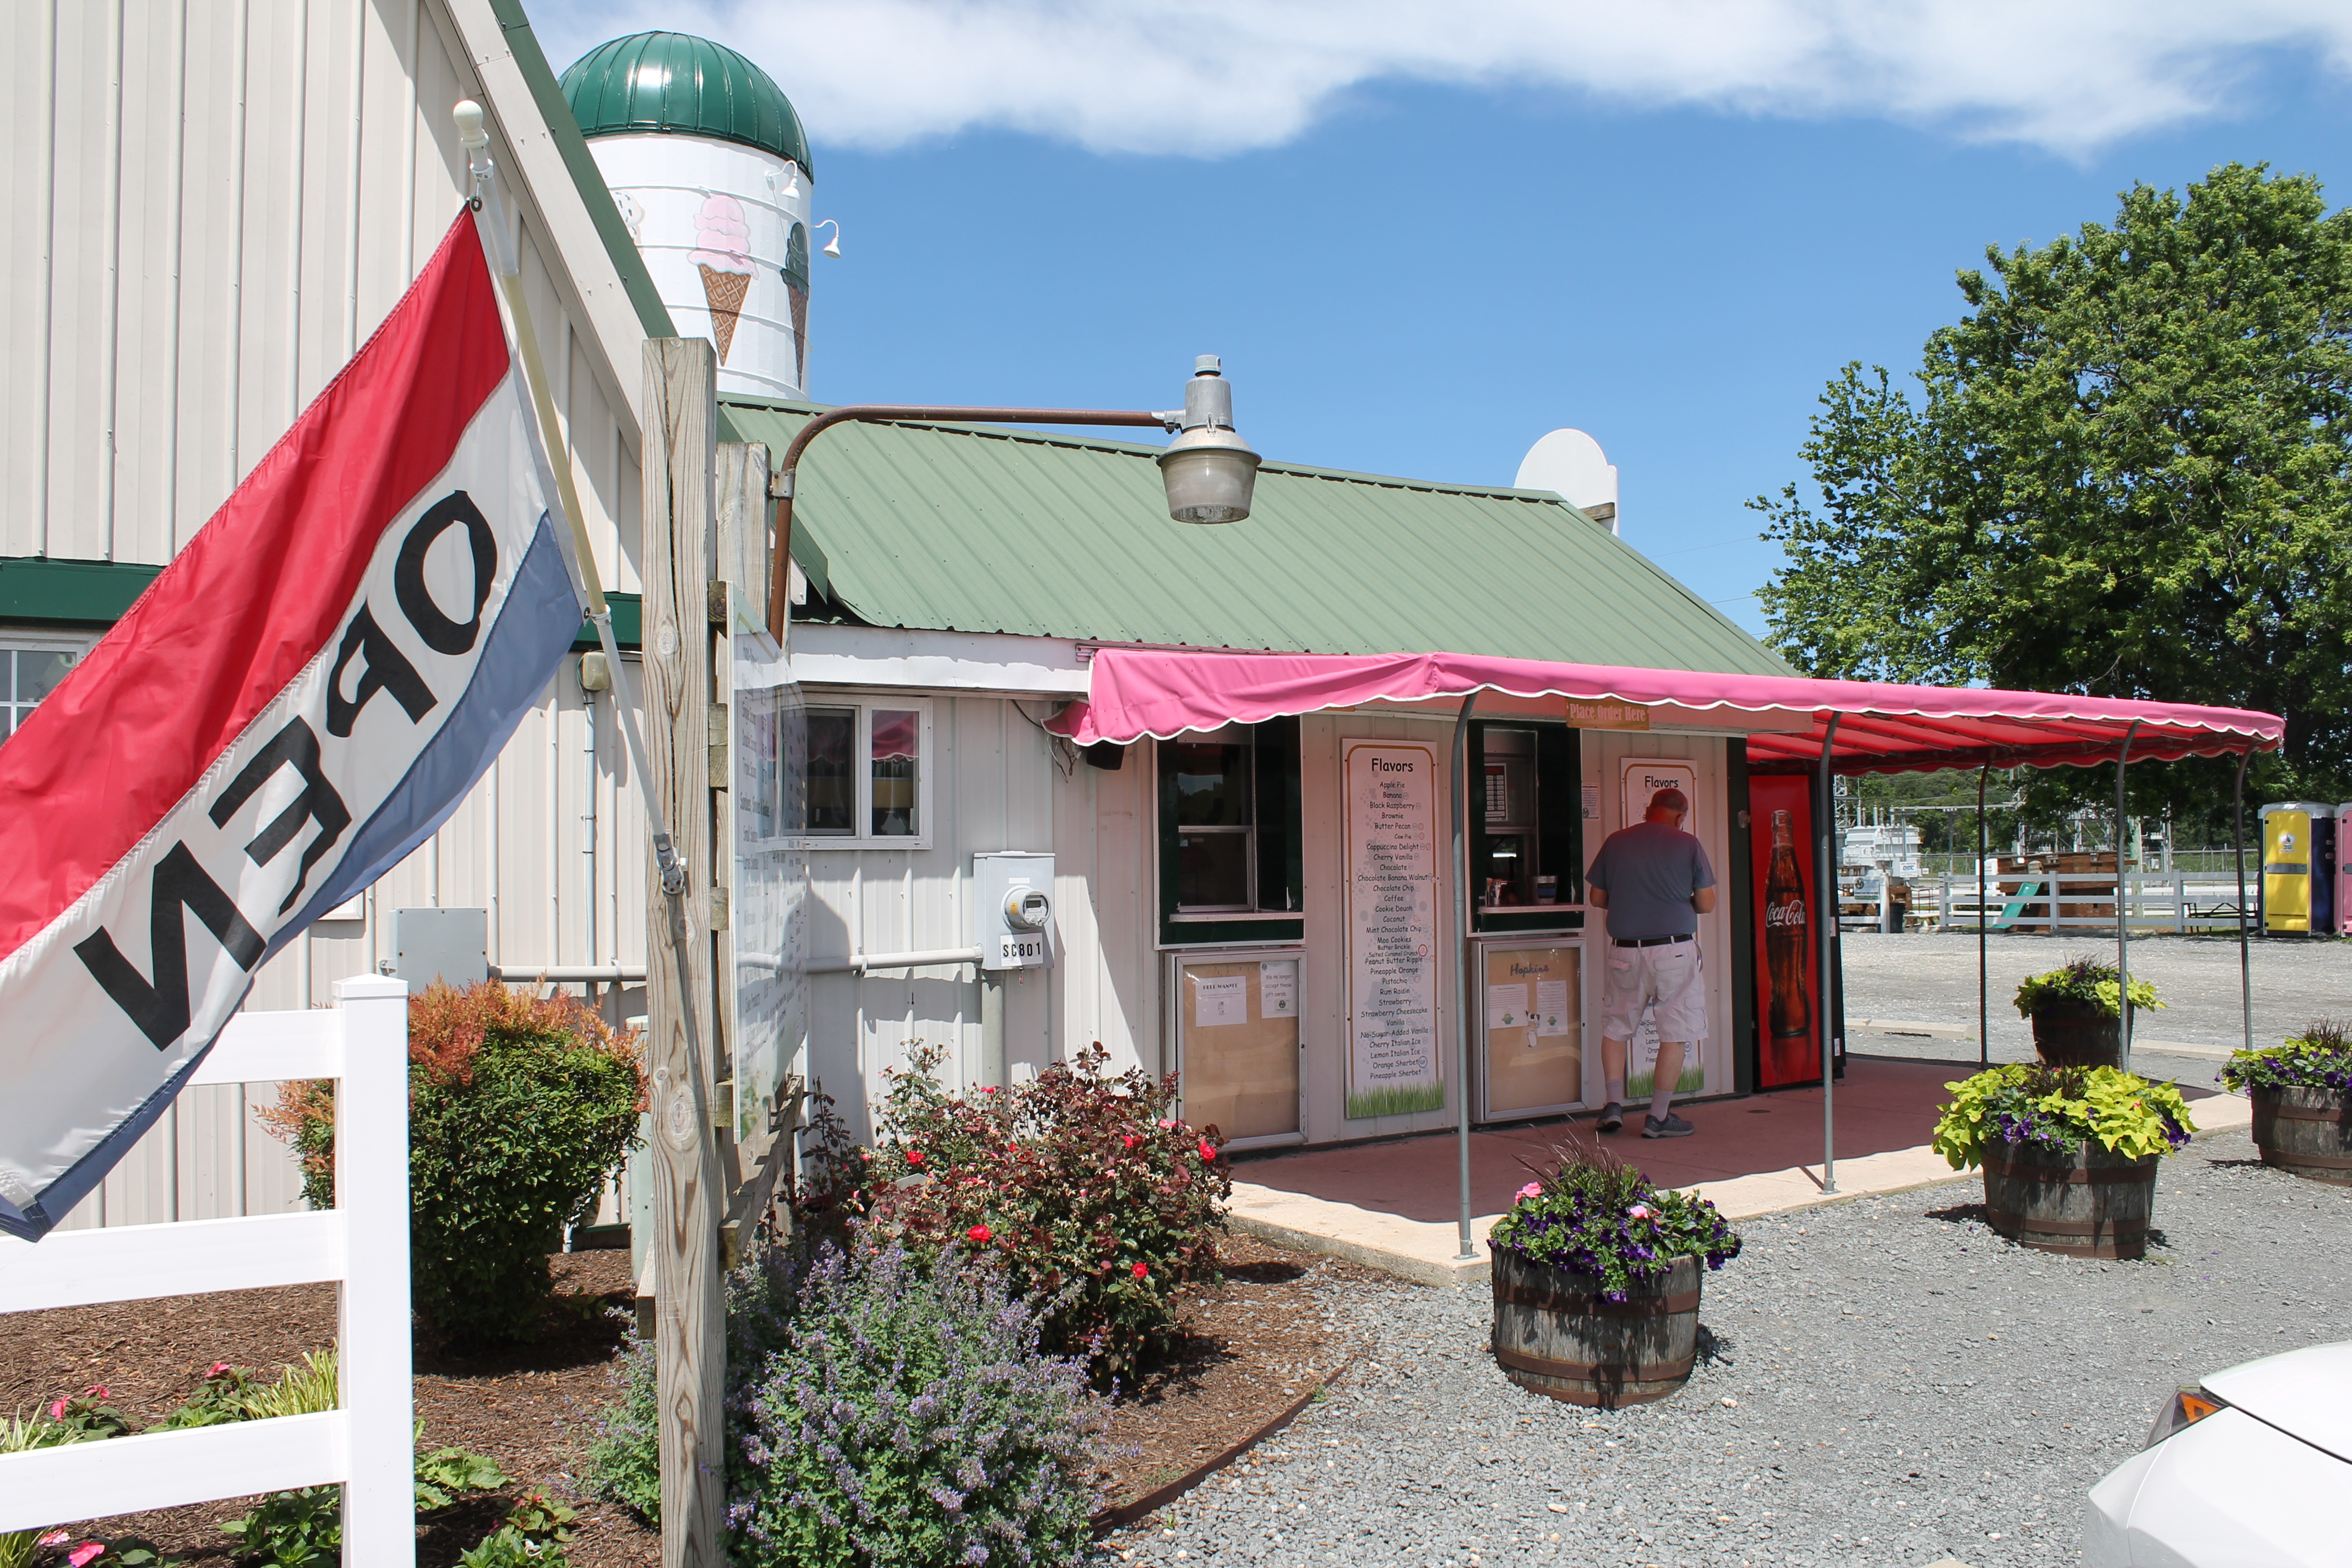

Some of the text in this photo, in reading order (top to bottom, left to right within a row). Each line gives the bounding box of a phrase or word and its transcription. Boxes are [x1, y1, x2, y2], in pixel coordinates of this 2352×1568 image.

[1570, 703, 1646, 722] Place Order Here
[1371, 758, 1413, 772] Flavors
[1645, 775, 1678, 788] Flavors
[1386, 802, 1414, 810] Raspberry
[1366, 843, 1419, 852] Cappuccino Delight
[1765, 900, 1805, 928] Coca-Cola
[1003, 942, 1041, 957] SC801
[1407, 956, 1423, 964] Ripple
[1370, 967, 1418, 976] Pineapple Orange
[1510, 963, 1550, 978] Hopkins
[1360, 1029, 1409, 1039] No-Sugar-Added
[1370, 1072, 1397, 1080] Pineapple
